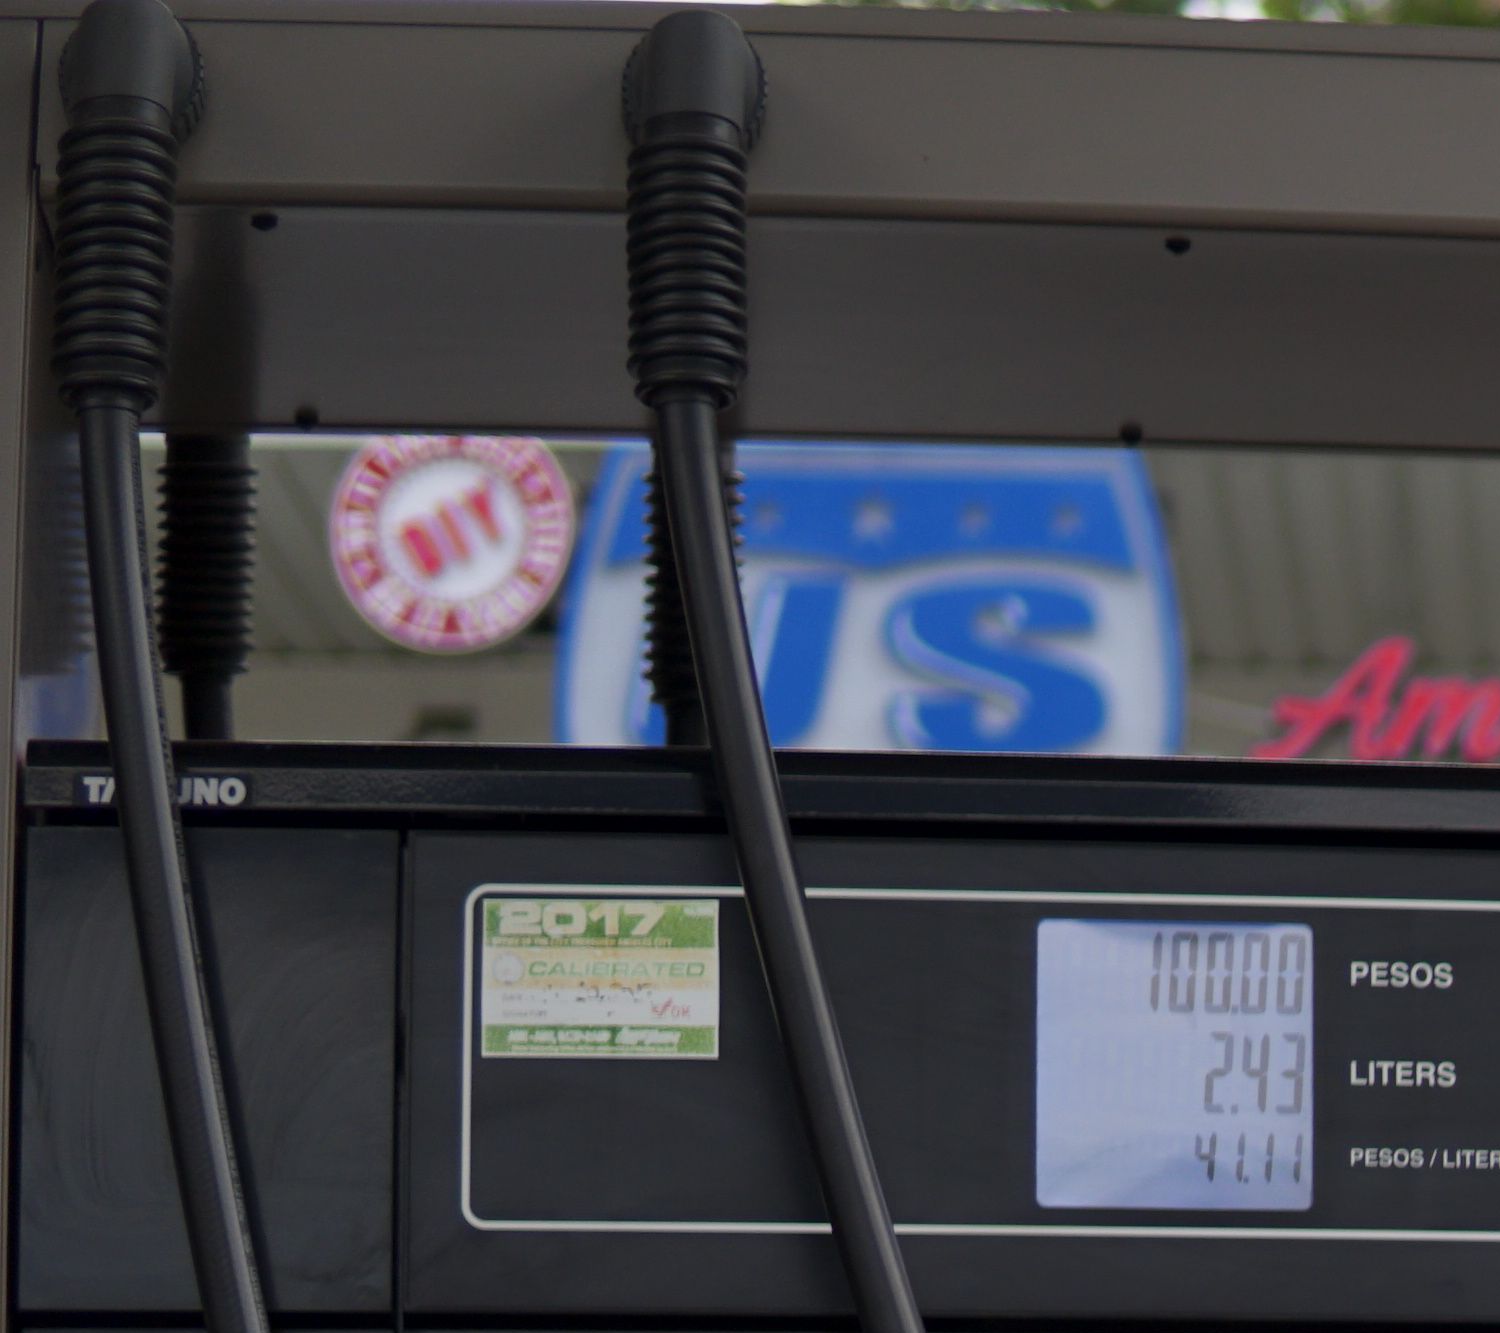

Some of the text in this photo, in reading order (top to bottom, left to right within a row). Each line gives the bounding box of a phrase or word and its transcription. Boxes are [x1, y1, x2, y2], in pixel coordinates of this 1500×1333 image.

[499, 903, 665, 936] 2017
[528, 960, 705, 978] CALIBRATED
[1350, 962, 1453, 988] PESOS
[1203, 1032, 1306, 1114] 2.43
[1350, 1061, 1456, 1087] LITERS
[1195, 1132, 1301, 1184] 41.11
[1350, 1148, 1424, 1168] PESOS
